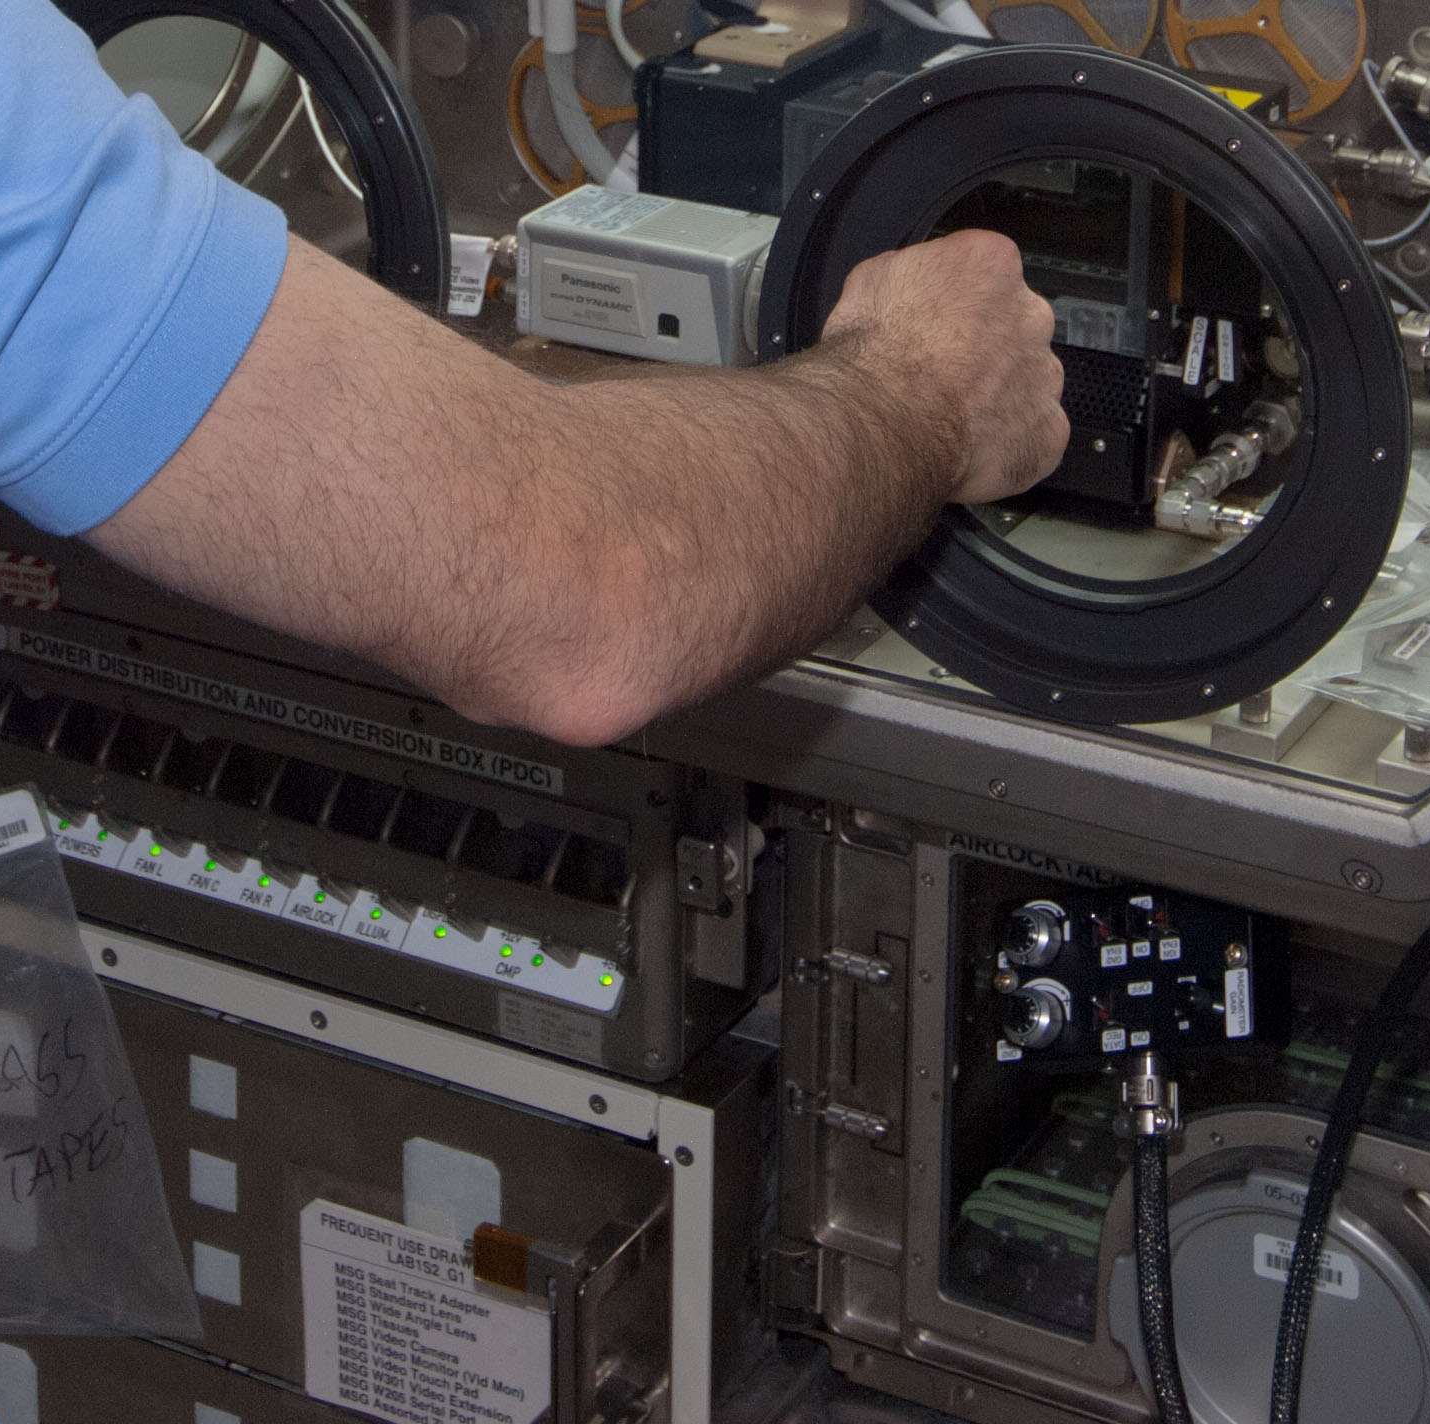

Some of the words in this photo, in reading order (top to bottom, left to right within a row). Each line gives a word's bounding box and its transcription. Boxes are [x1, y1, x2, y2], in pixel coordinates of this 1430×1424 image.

[560, 273, 622, 295] Panasonic
[575, 294, 634, 314] DYNAMIC
[1187, 317, 1205, 383] SCALE
[19, 633, 93, 670] POWER
[96, 652, 240, 709] DISTRIBUTION
[243, 693, 289, 721] AND
[292, 705, 434, 760] CONVERSION
[439, 742, 486, 773] BOX
[490, 753, 552, 790] (PDC)
[134, 856, 157, 875] FAN
[949, 832, 1062, 874] AIRLOCK
[187, 872, 211, 890] FAN
[239, 888, 263, 905] FAN
[291, 904, 337, 927] AIRLOCK
[495, 961, 522, 979] CMP
[1236, 970, 1247, 1035] RADIOMETER
[320, 1212, 394, 1247] FREQUENT
[397, 1237, 426, 1258] USE
[429, 1244, 474, 1269] DRAW
[334, 1261, 365, 1281] MSG
[368, 1270, 397, 1290] Seat
[400, 1281, 436, 1303] Track
[439, 1293, 491, 1319] Adapter
[335, 1275, 366, 1295] MSG
[368, 1285, 427, 1313] Standard
[430, 1304, 462, 1324] Lens
[336, 1289, 366, 1309] MSG
[369, 1299, 402, 1320] Wide
[404, 1310, 443, 1333] Angle
[445, 1323, 477, 1343] Lens
[336, 1303, 367, 1322] MSG
[369, 1314, 420, 1339] Tissues
[337, 1316, 368, 1336] MSG
[370, 1327, 407, 1349] Video
[409, 1339, 460, 1365] Camera
[338, 1330, 368, 1350] MSG
[371, 1340, 408, 1363] Video
[410, 1352, 460, 1379] Monitor
[462, 1367, 489, 1389] (Vid
[491, 1378, 525, 1402] Mon)
[338, 1344, 369, 1364] MSG
[371, 1354, 408, 1377] Video
[410, 1367, 451, 1390] Touch
[454, 1381, 480, 1400] Pad
